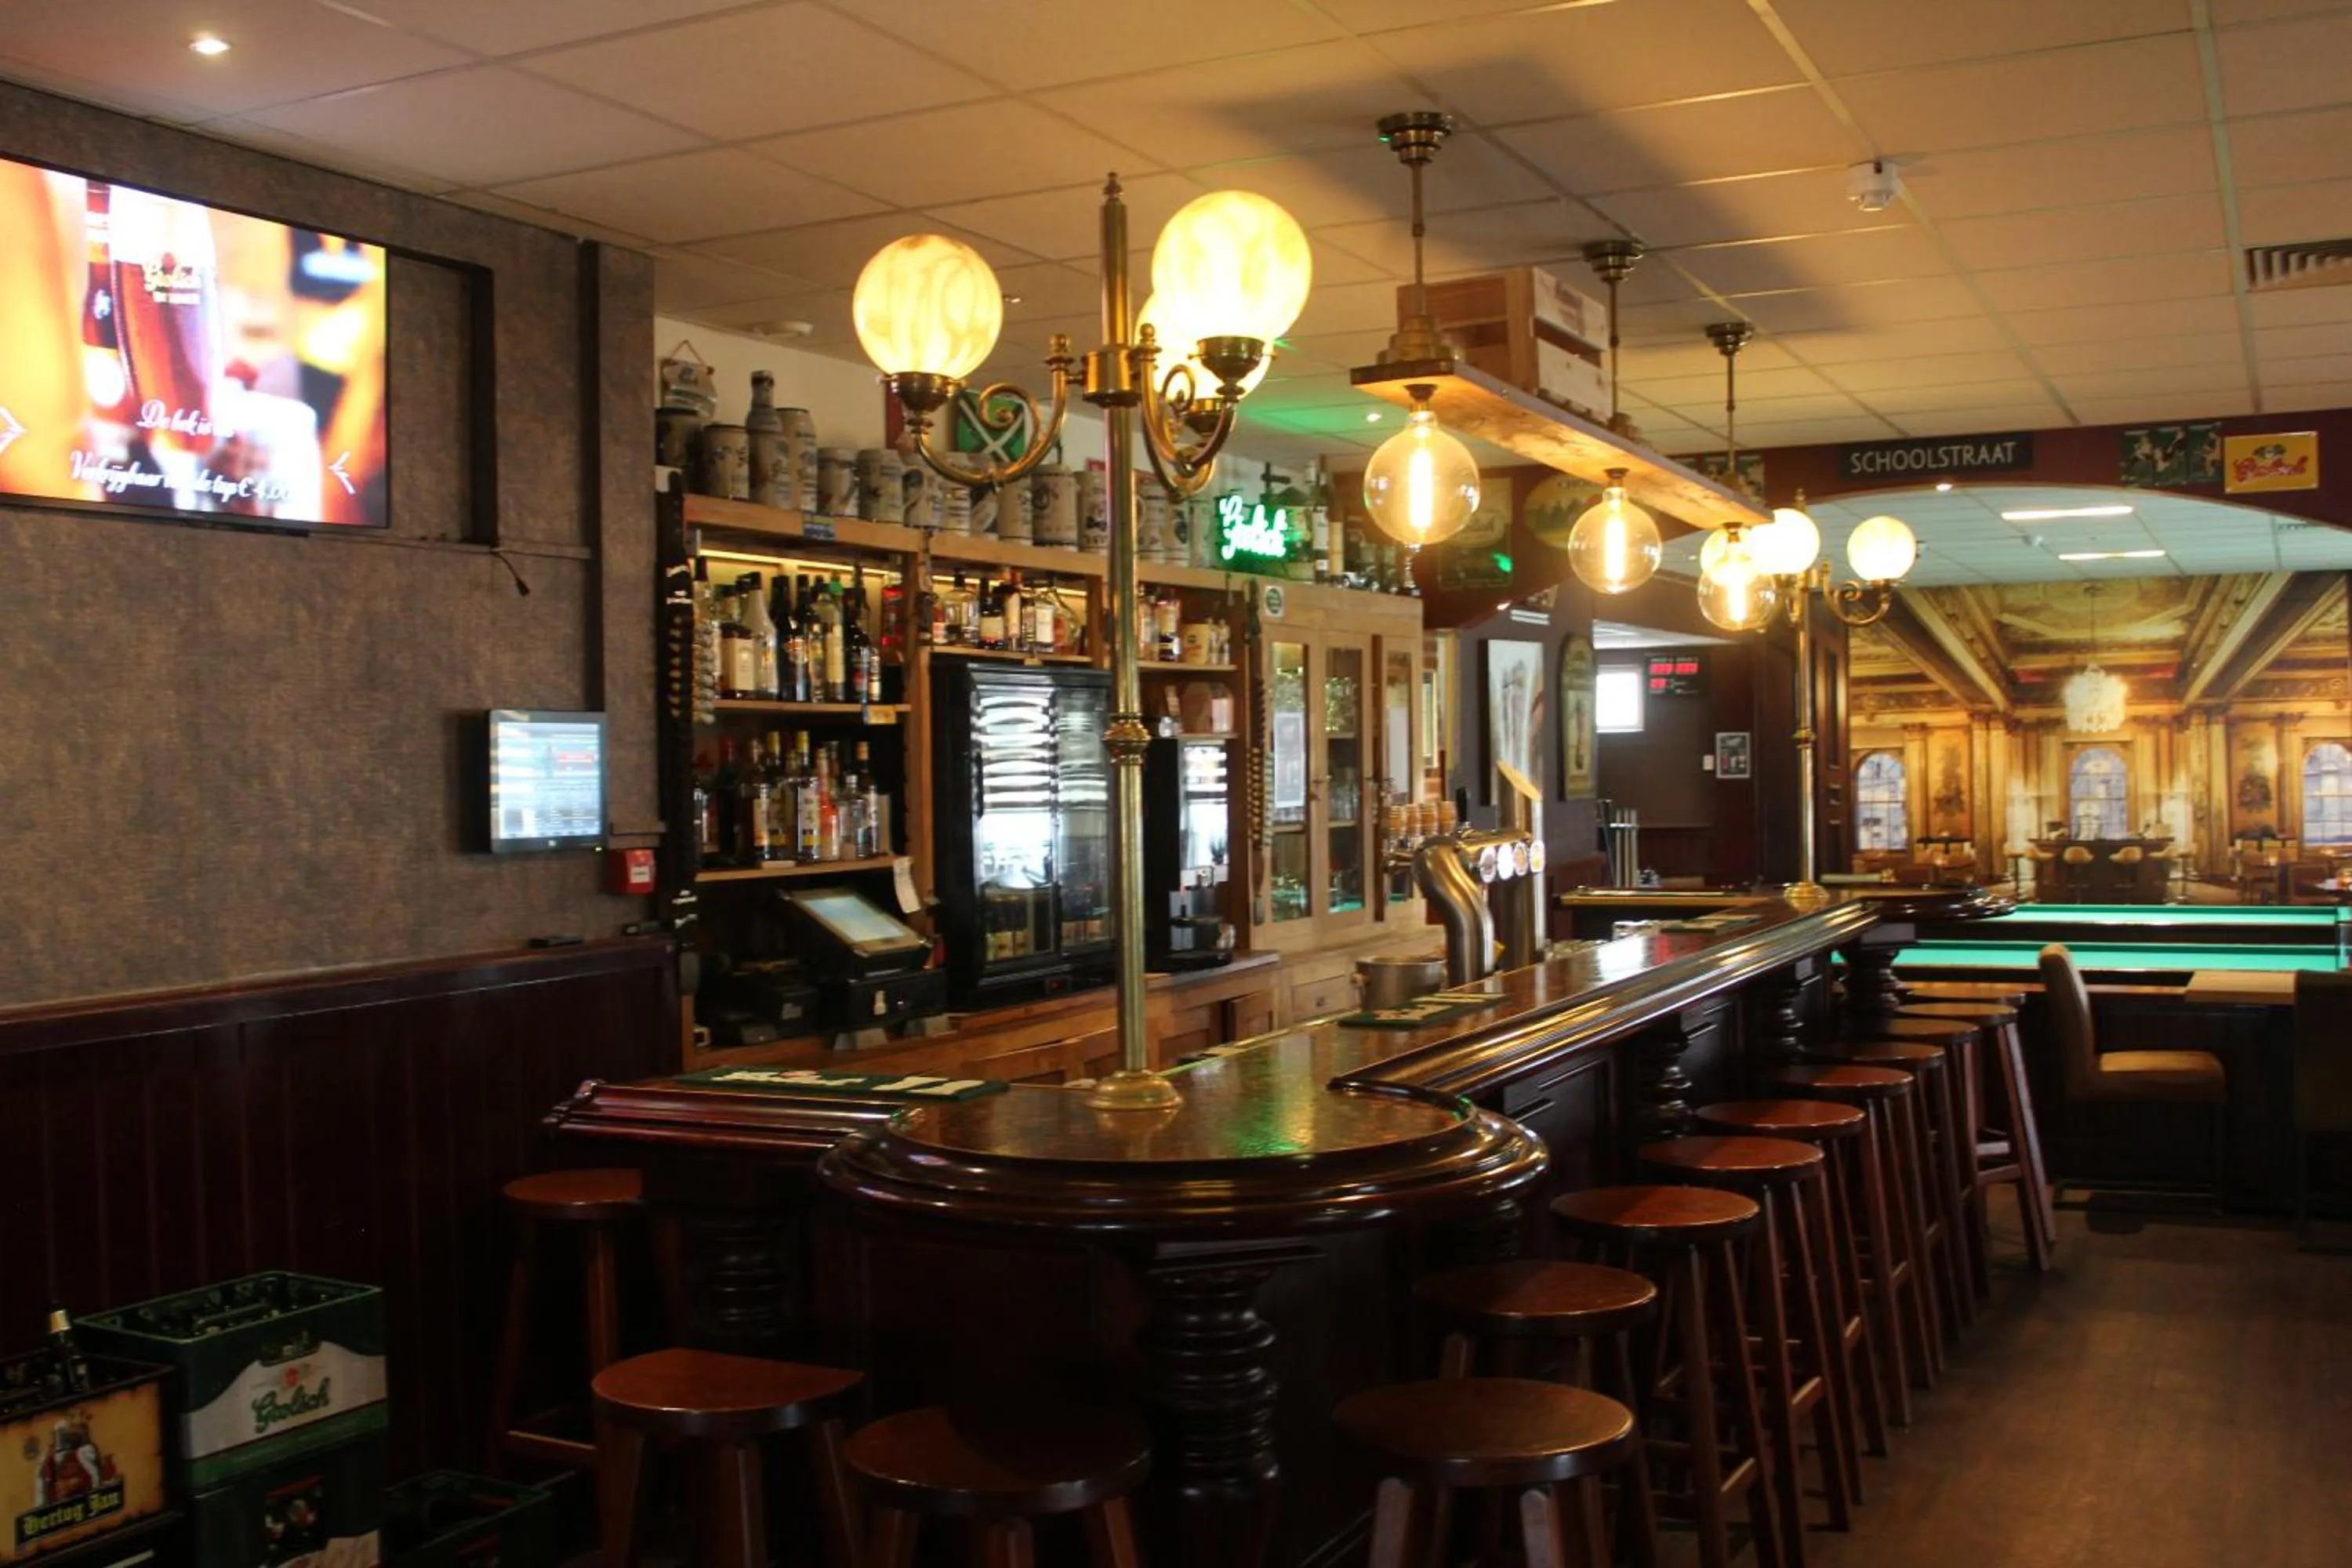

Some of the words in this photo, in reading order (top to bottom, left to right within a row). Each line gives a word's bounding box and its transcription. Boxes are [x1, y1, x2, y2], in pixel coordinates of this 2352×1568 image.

[1850, 441, 2017, 474] SCHOOLSTRAAT
[251, 1376, 331, 1434] Grolsch
[22, 1503, 87, 1537] Hertog
[86, 1490, 122, 1518] Jan
